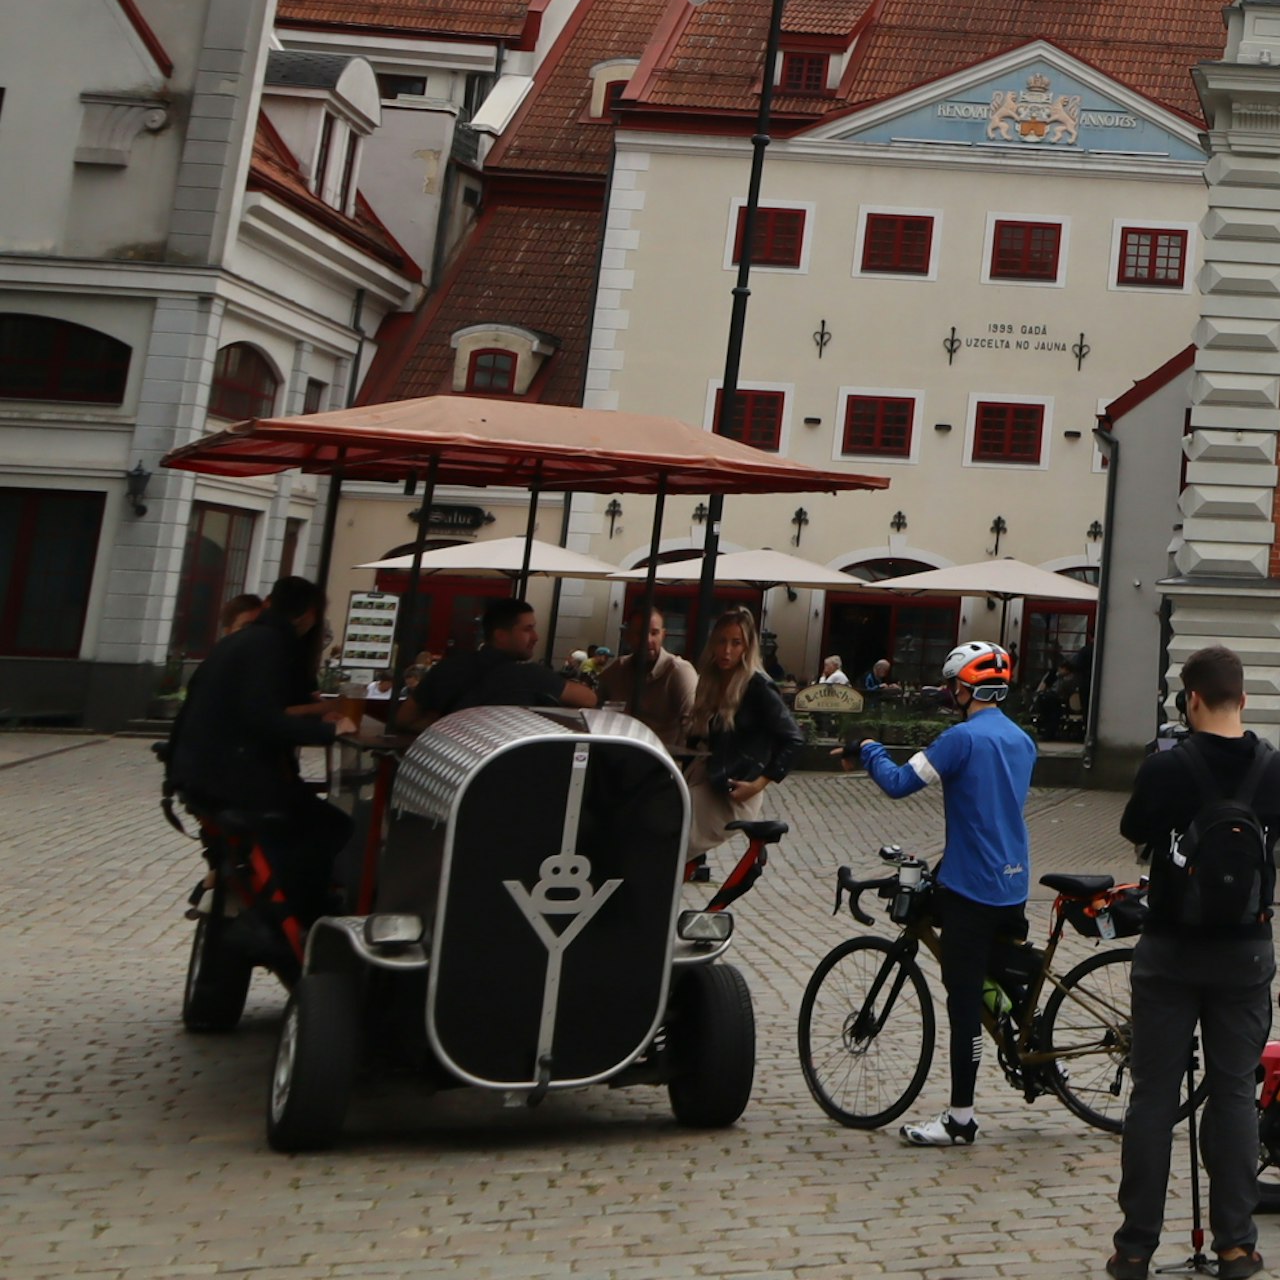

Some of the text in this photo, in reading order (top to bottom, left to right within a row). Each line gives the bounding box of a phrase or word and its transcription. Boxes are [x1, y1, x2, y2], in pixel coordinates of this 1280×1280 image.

[937, 104, 990, 120] RENOVAT
[965, 338, 1067, 352] UZCELTA NO JAUNA
